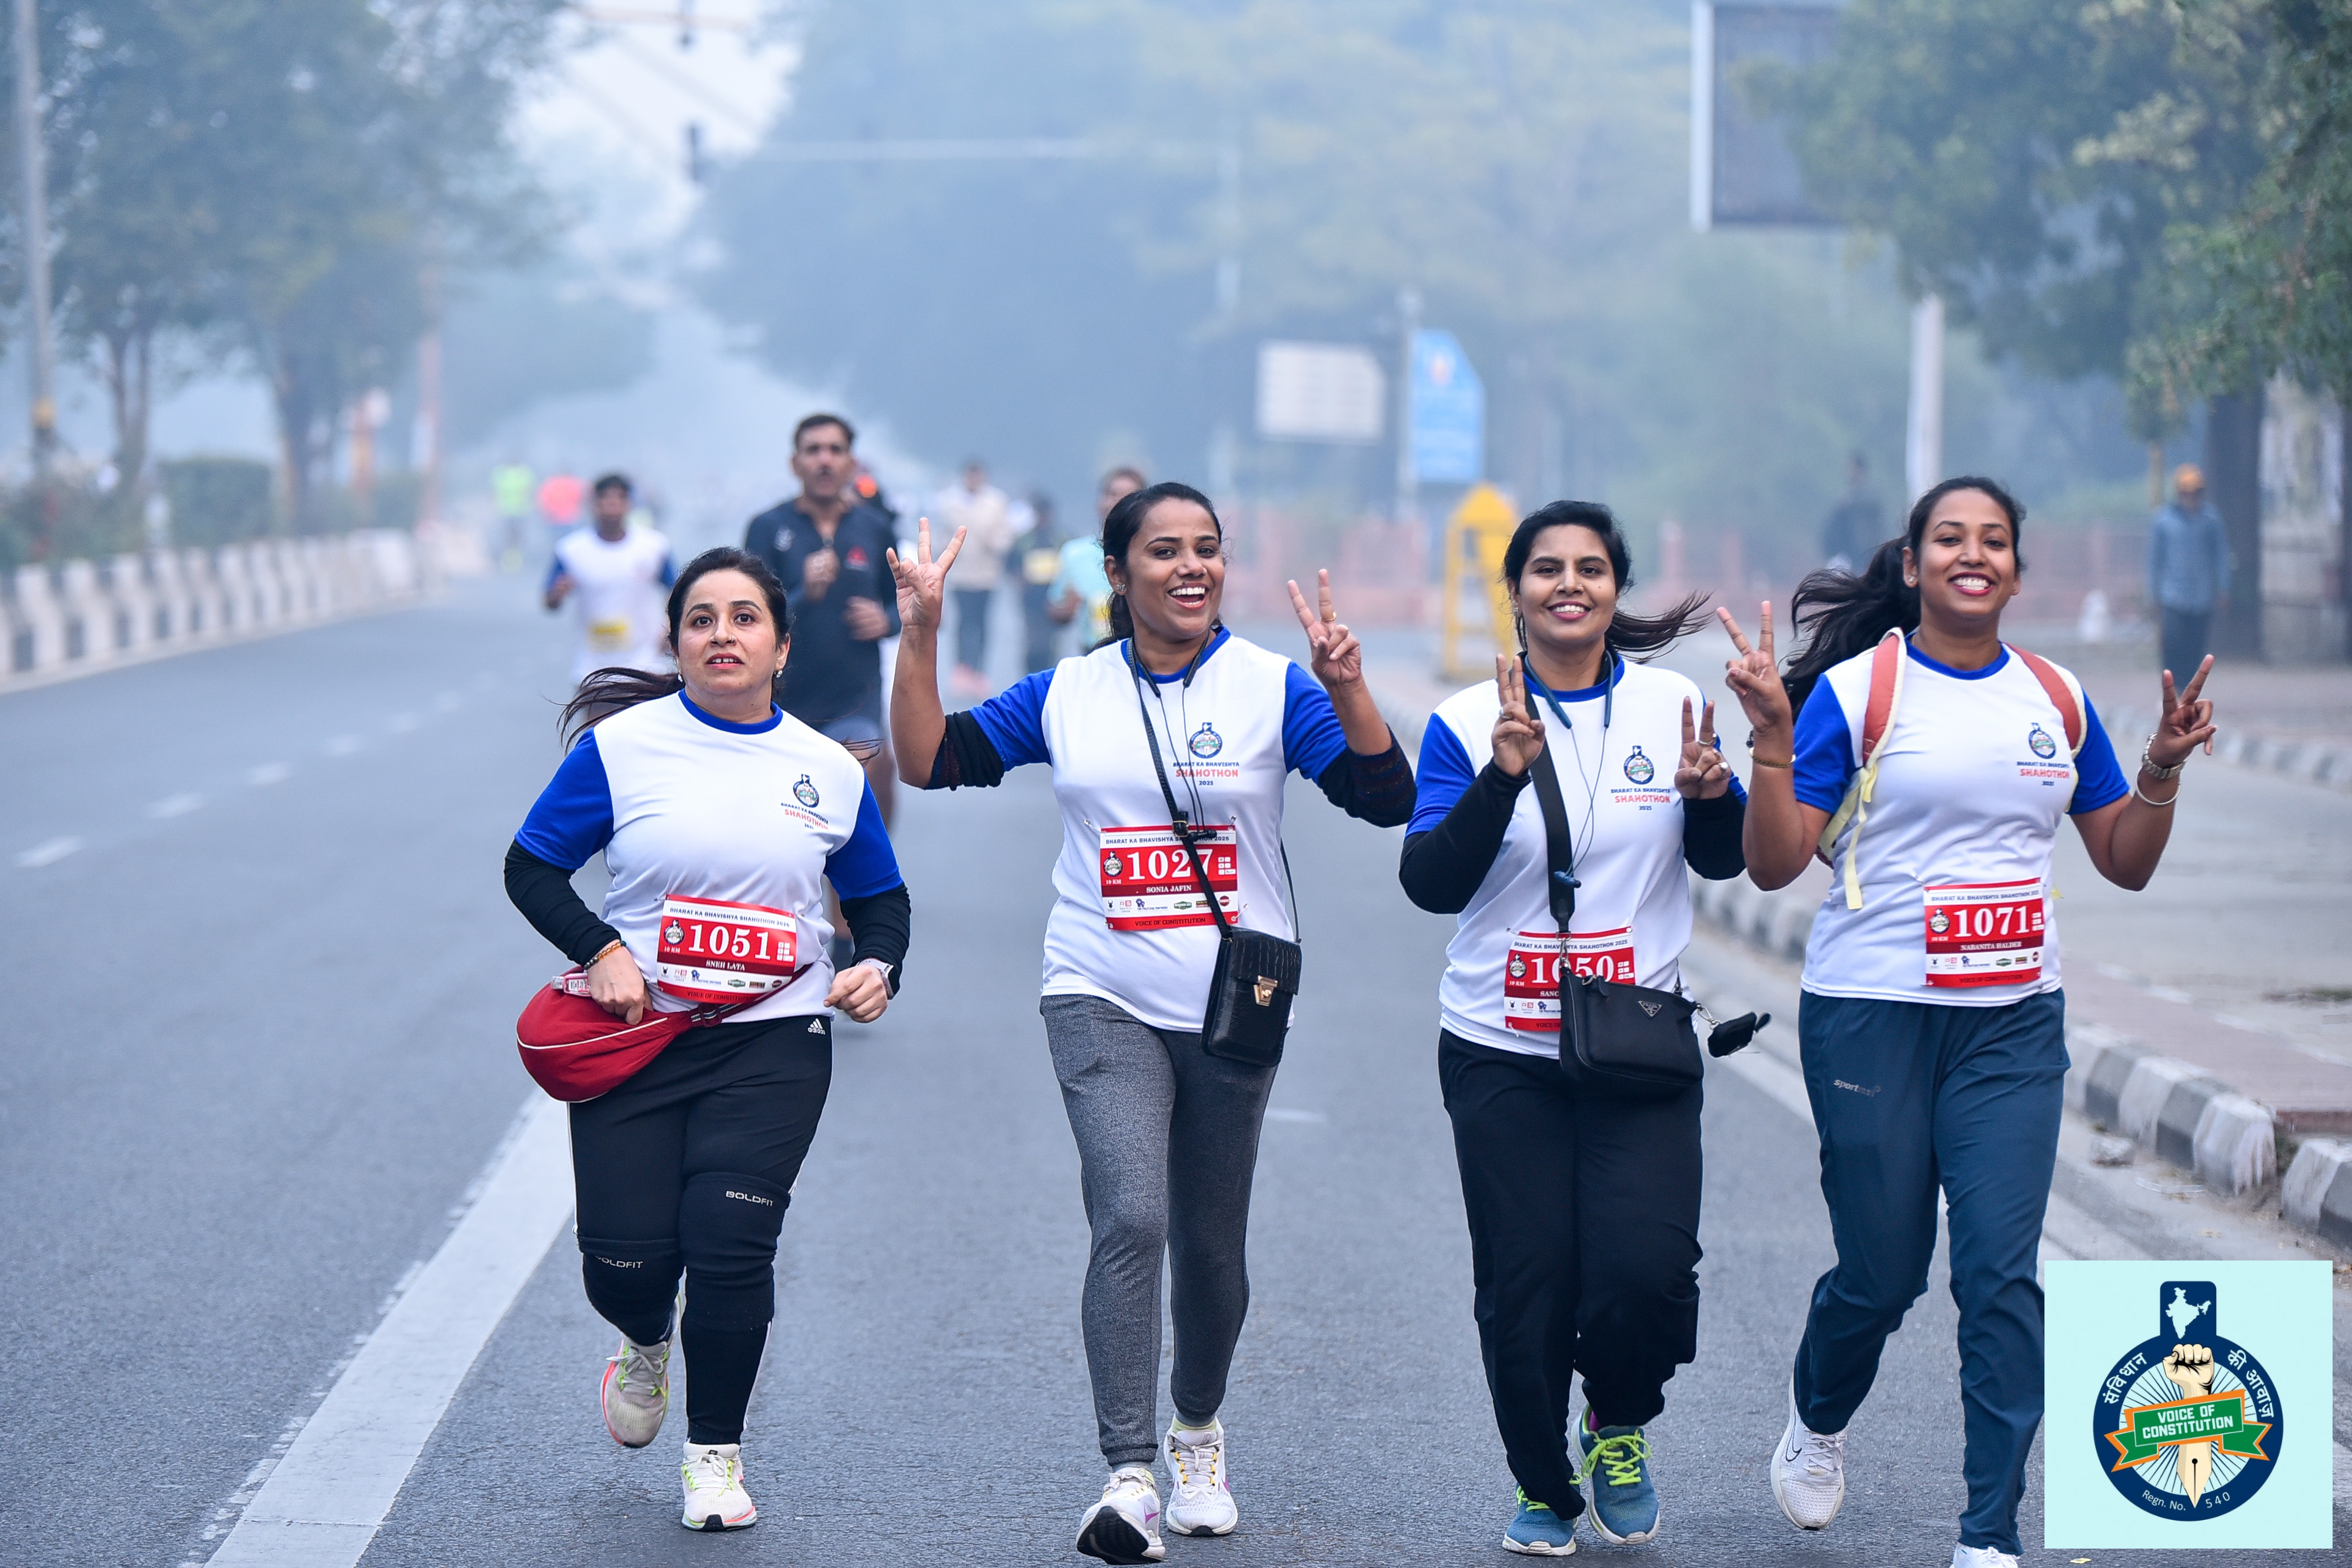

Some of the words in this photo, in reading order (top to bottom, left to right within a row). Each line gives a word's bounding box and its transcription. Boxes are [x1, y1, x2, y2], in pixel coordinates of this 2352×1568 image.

[1176, 769, 1238, 777] SHAHOTHON
[1615, 794, 1671, 803] SHAHOTHON
[1127, 849, 1212, 880] 1027
[1953, 905, 2030, 937] 1071
[688, 924, 771, 960] 1051
[706, 959, 726, 969] SNEH
[727, 961, 745, 971] LATA
[1531, 955, 1614, 983] 1050
[726, 1191, 774, 1207] BOLDFIT
[595, 1256, 643, 1269] OLDFIT
